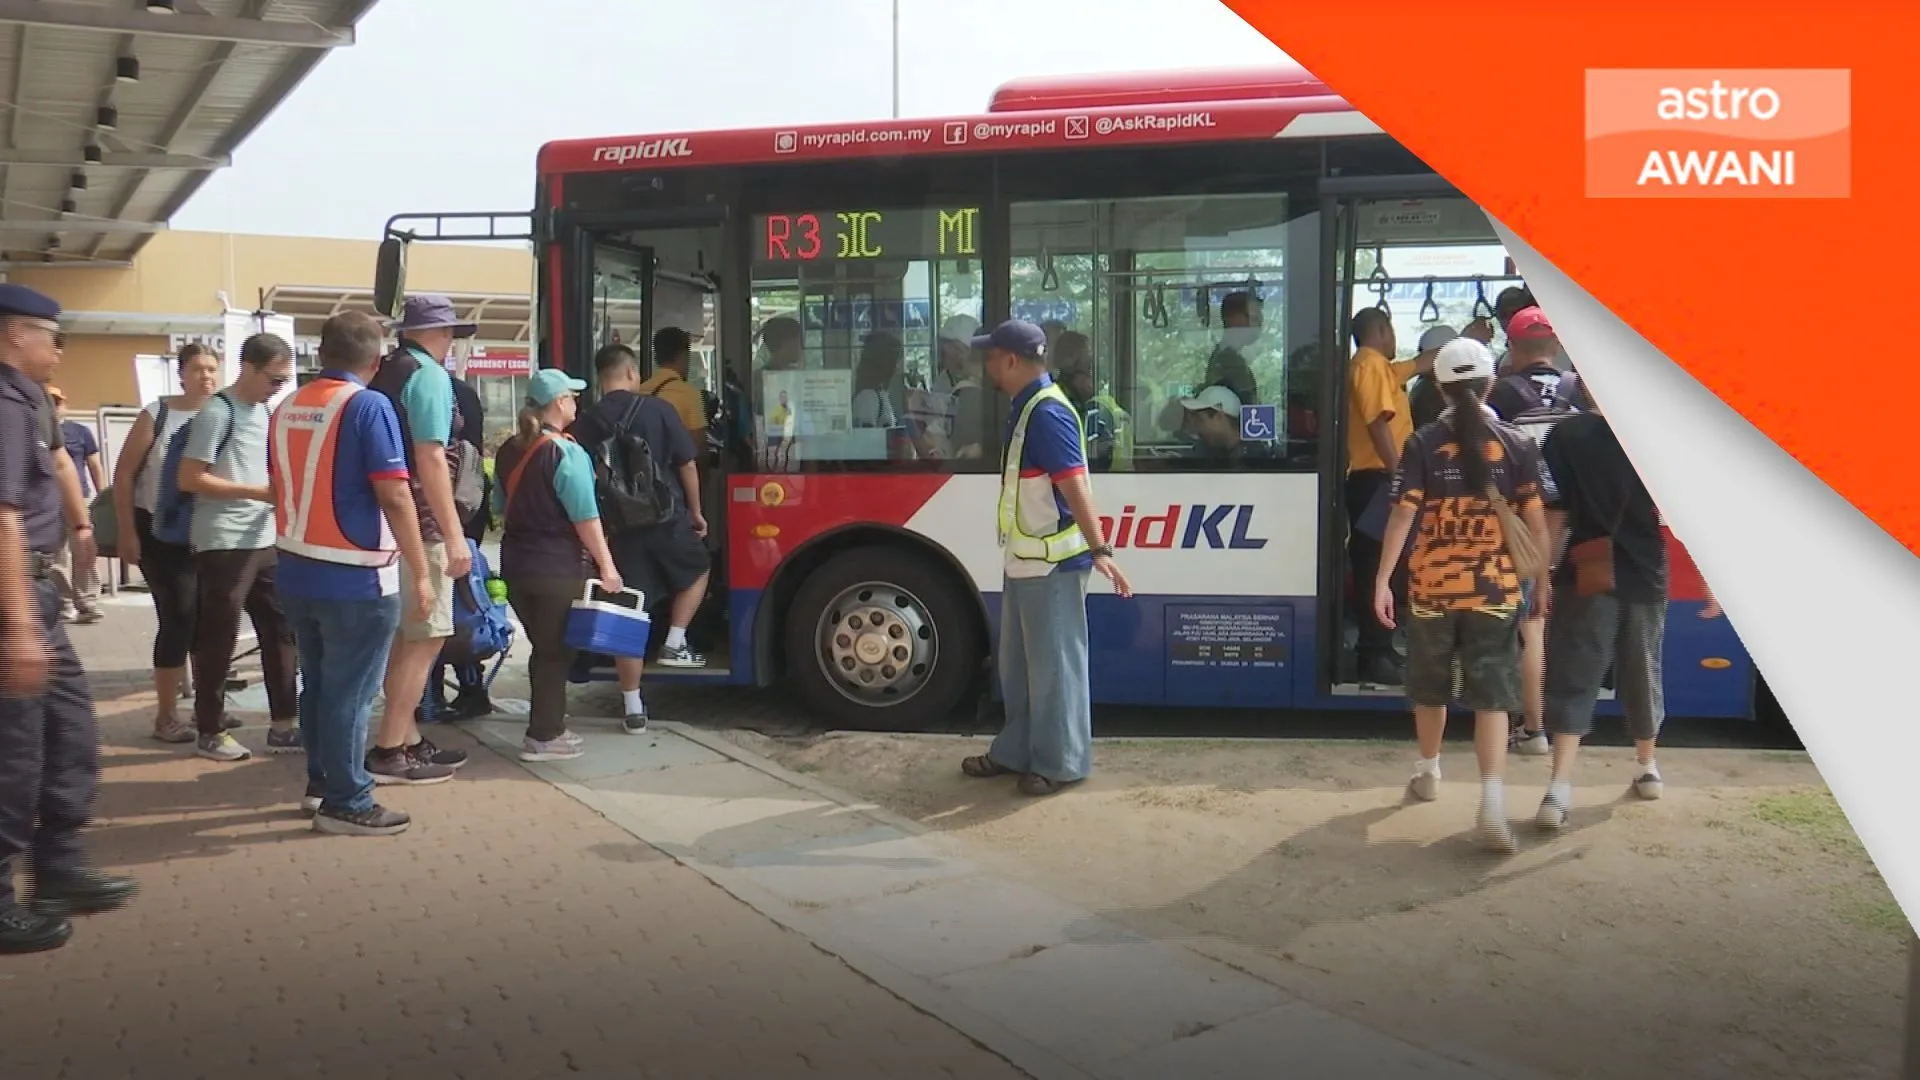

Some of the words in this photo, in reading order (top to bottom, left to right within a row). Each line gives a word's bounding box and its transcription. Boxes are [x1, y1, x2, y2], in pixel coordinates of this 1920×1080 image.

[803, 128, 932, 147] myrapid.com.my
[973, 120, 1056, 139] @myrapid
[1095, 112, 1217, 136] @AskRapidKL
[592, 138, 693, 164] rapidKL
[767, 213, 821, 259] R3
[468, 359, 507, 368] CURRENCY
